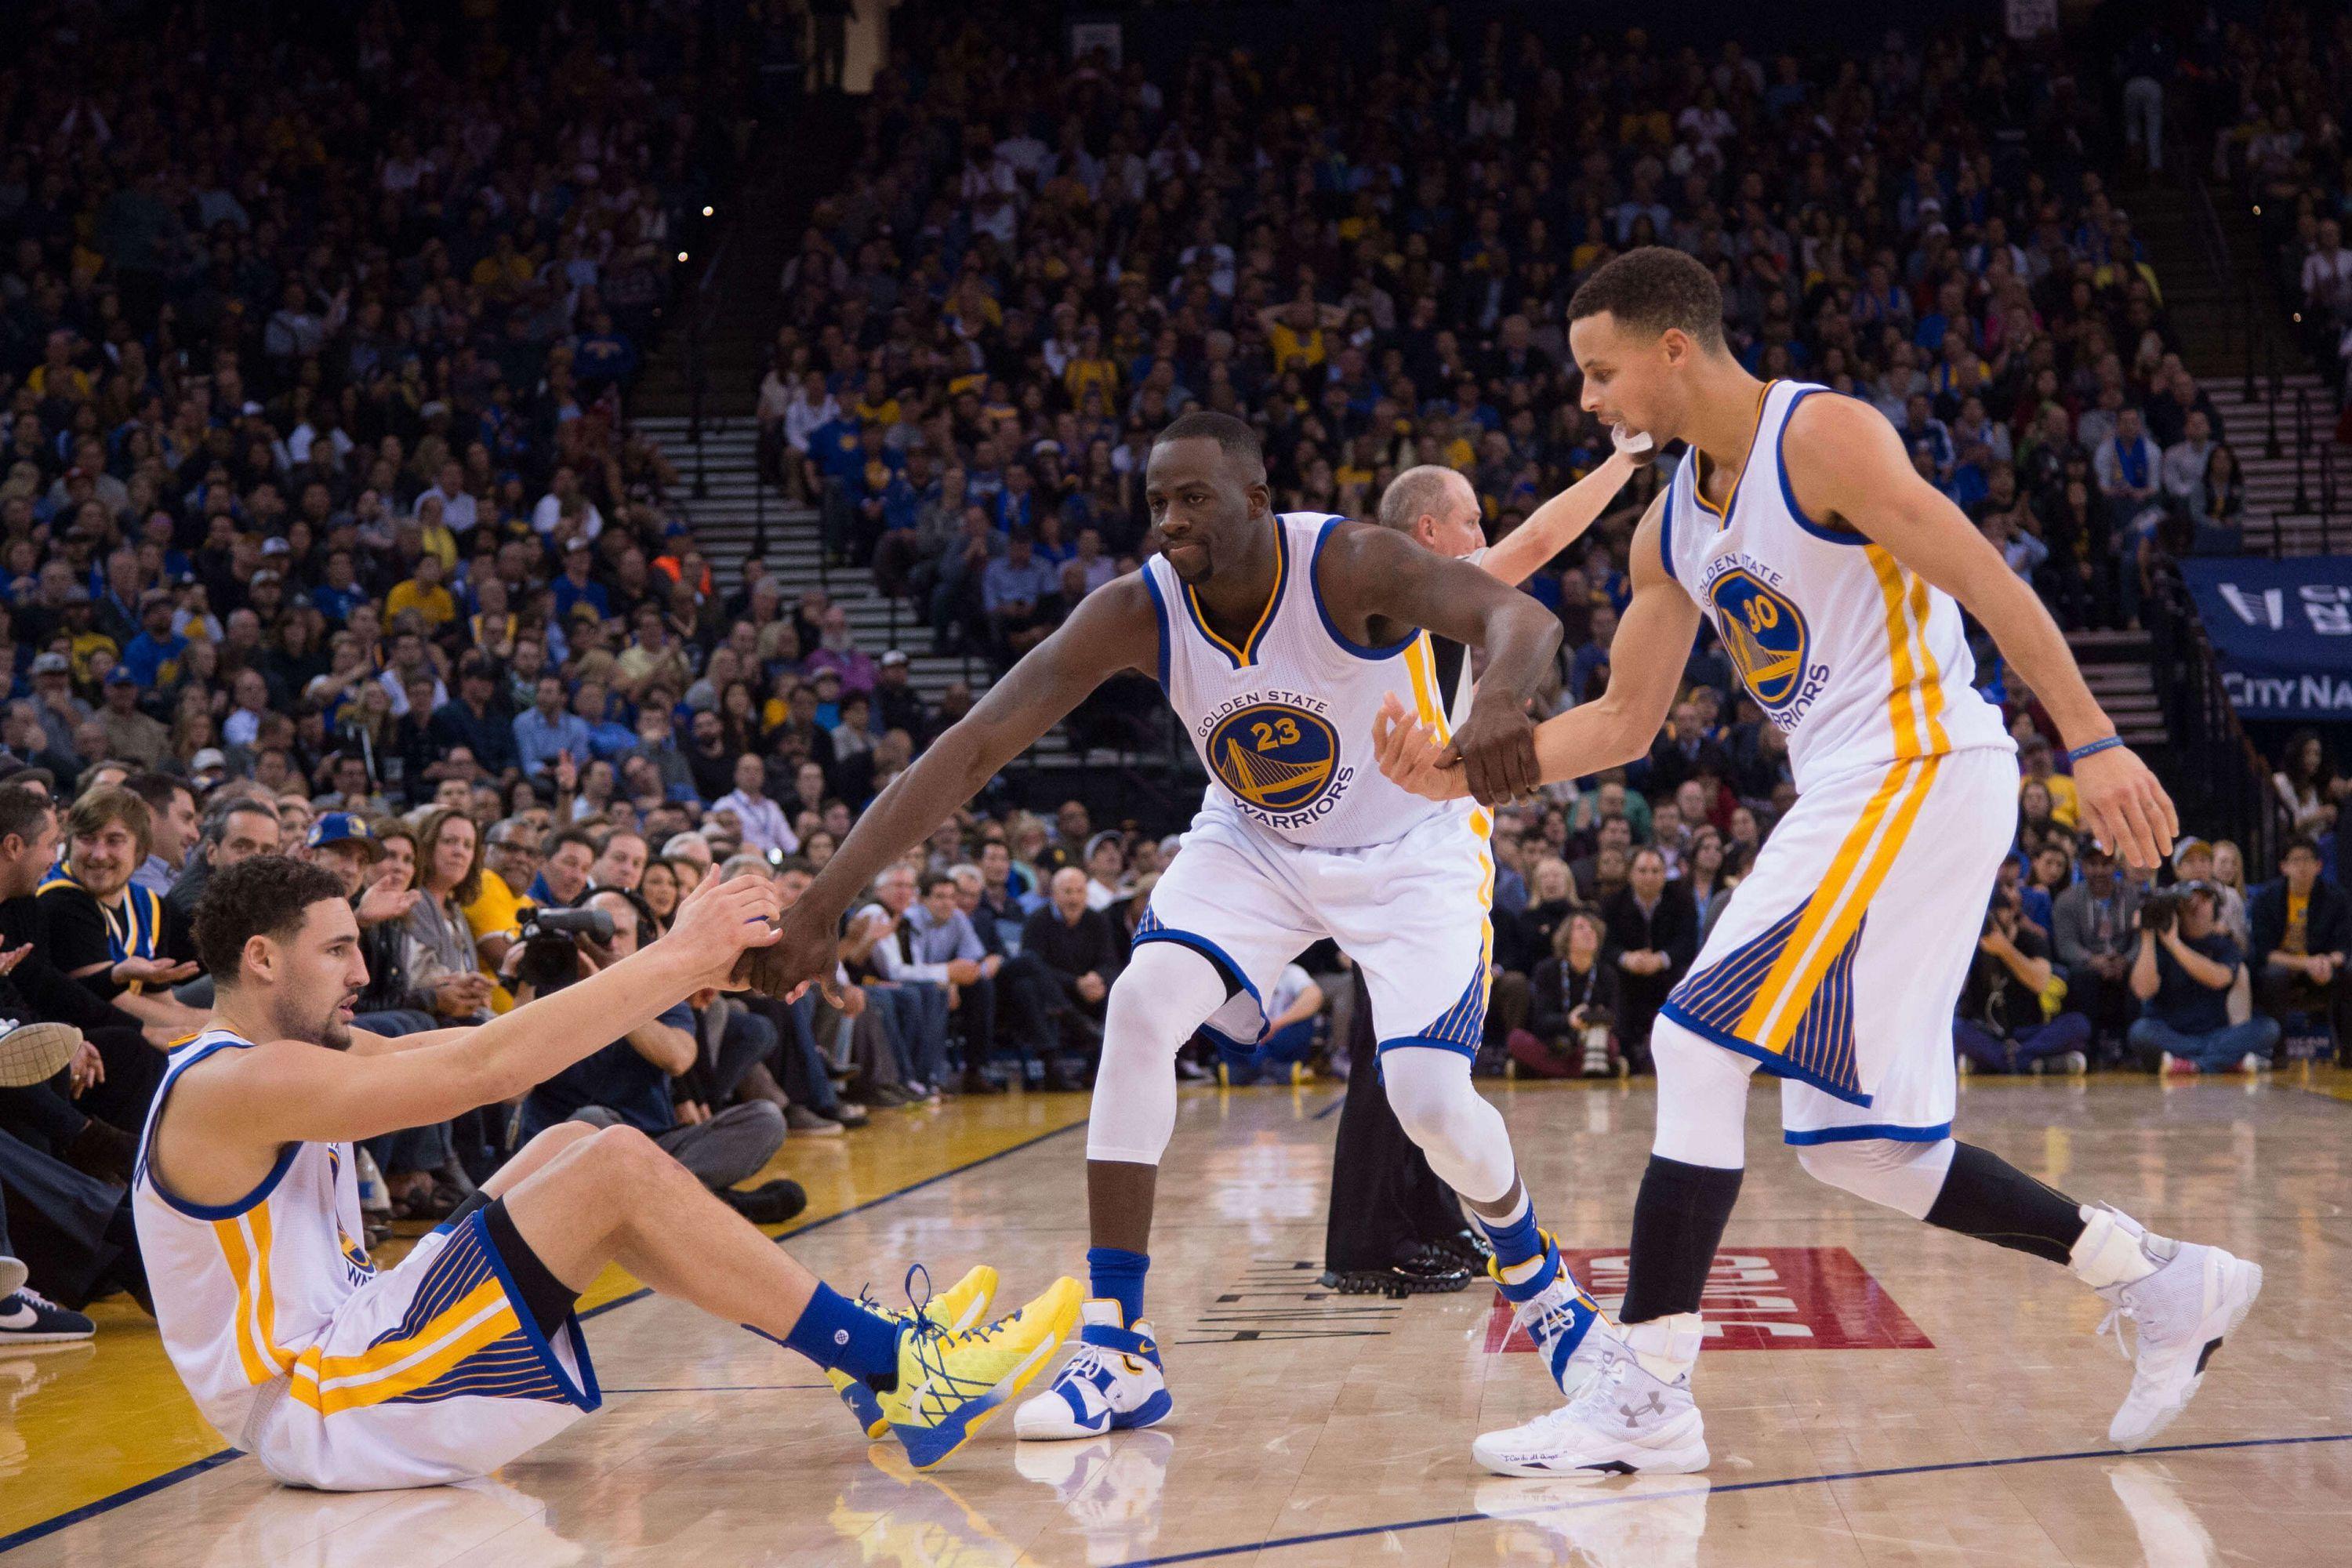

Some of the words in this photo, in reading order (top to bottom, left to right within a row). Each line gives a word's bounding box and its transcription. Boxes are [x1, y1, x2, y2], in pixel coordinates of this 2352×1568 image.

[1742, 553, 1784, 587] TATE
[1743, 594, 1778, 633] 30
[1197, 691, 1260, 738] GOLDEN
[1268, 690, 1327, 713] STATE
[1250, 717, 1301, 752] 23
[1233, 765, 1354, 829] WARRIORS
